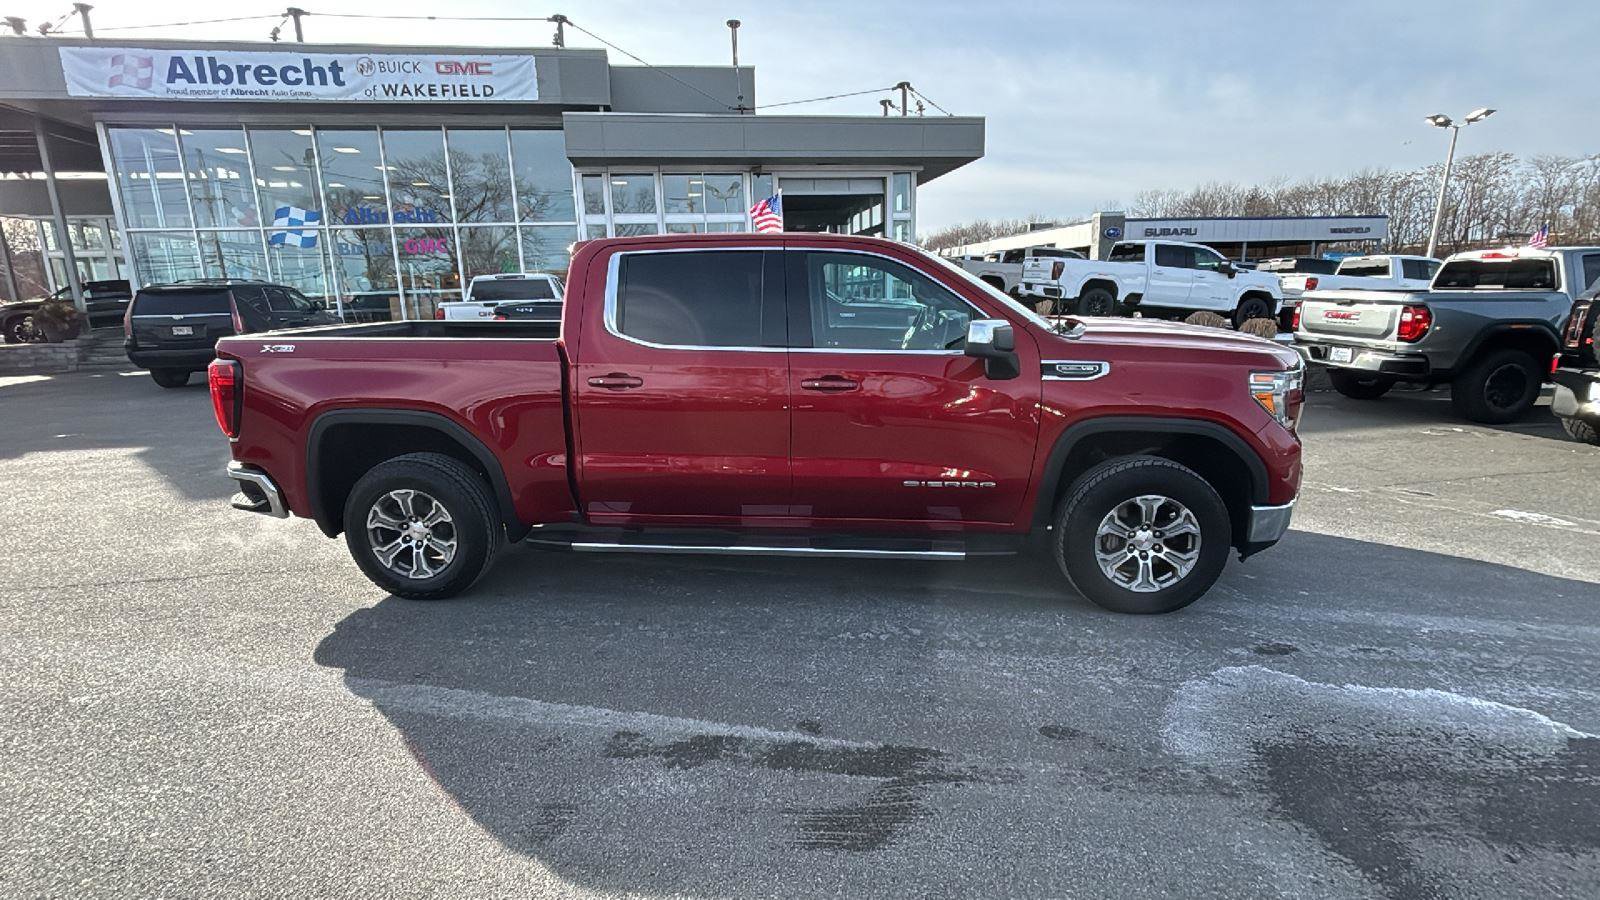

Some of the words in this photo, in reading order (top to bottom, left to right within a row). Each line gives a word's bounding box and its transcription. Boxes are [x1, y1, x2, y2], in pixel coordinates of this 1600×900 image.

[166, 55, 346, 87] Albrecht
[379, 61, 421, 74] BUICK
[435, 61, 493, 75] GMC
[230, 88, 269, 96] Albrecht
[365, 85, 377, 98] of
[382, 83, 494, 98] WAKEFIELD
[1144, 227, 1198, 238] SUBARU
[404, 237, 448, 255] GMC
[1324, 310, 1361, 320] GMC
[903, 480, 997, 489] SIERRA
